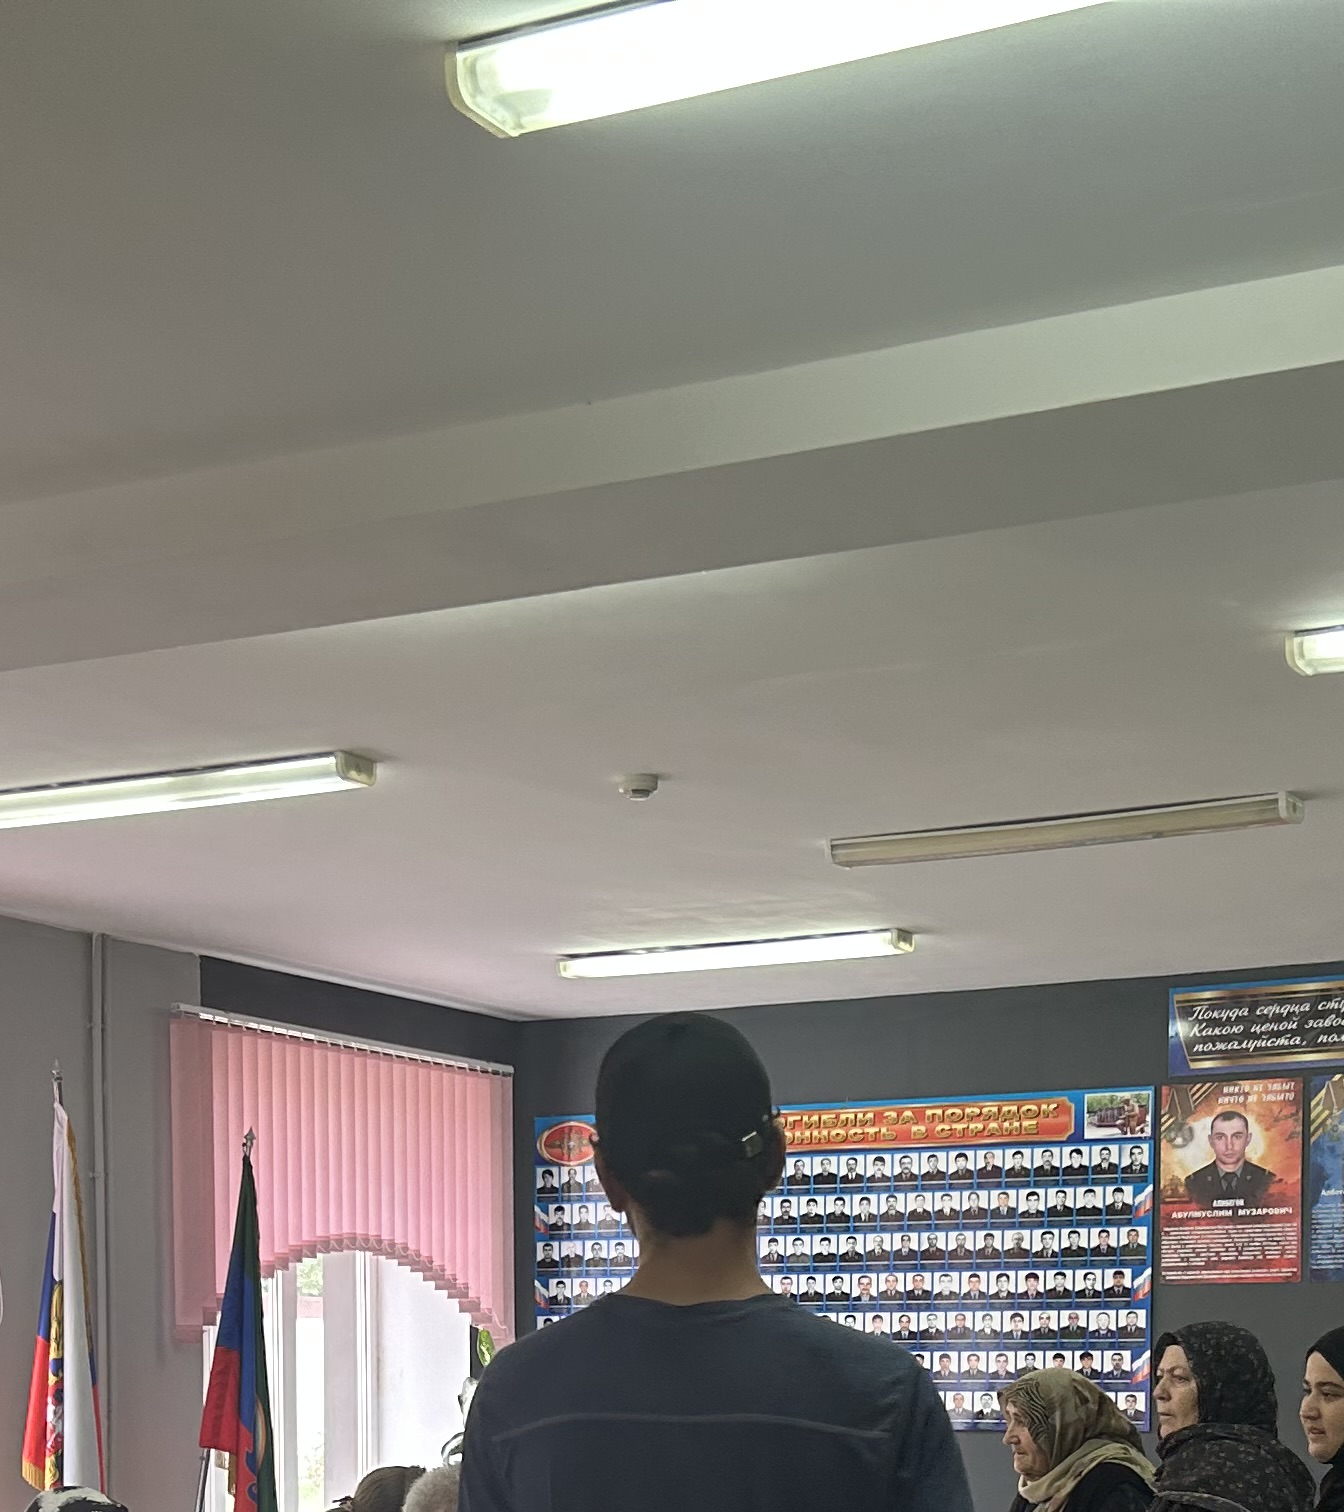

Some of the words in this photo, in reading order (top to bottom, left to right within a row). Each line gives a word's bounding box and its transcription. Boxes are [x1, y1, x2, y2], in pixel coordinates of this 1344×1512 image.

[1188, 1005, 1250, 1021] Покуда
[1256, 1002, 1311, 1019] сердца
[1189, 1024, 1244, 1037] Какою
[1250, 1017, 1298, 1034] ценой
[1193, 1034, 1307, 1052] пожалуйста,
[779, 1111, 876, 1131] ГИБЛИ
[883, 1108, 918, 1126] ЗА
[925, 1102, 1060, 1124] ПОРЯДОК
[784, 1126, 897, 1145] ОННОСТЬ
[911, 1125, 928, 1139] В
[935, 1121, 1040, 1138] СТРАНЕ
